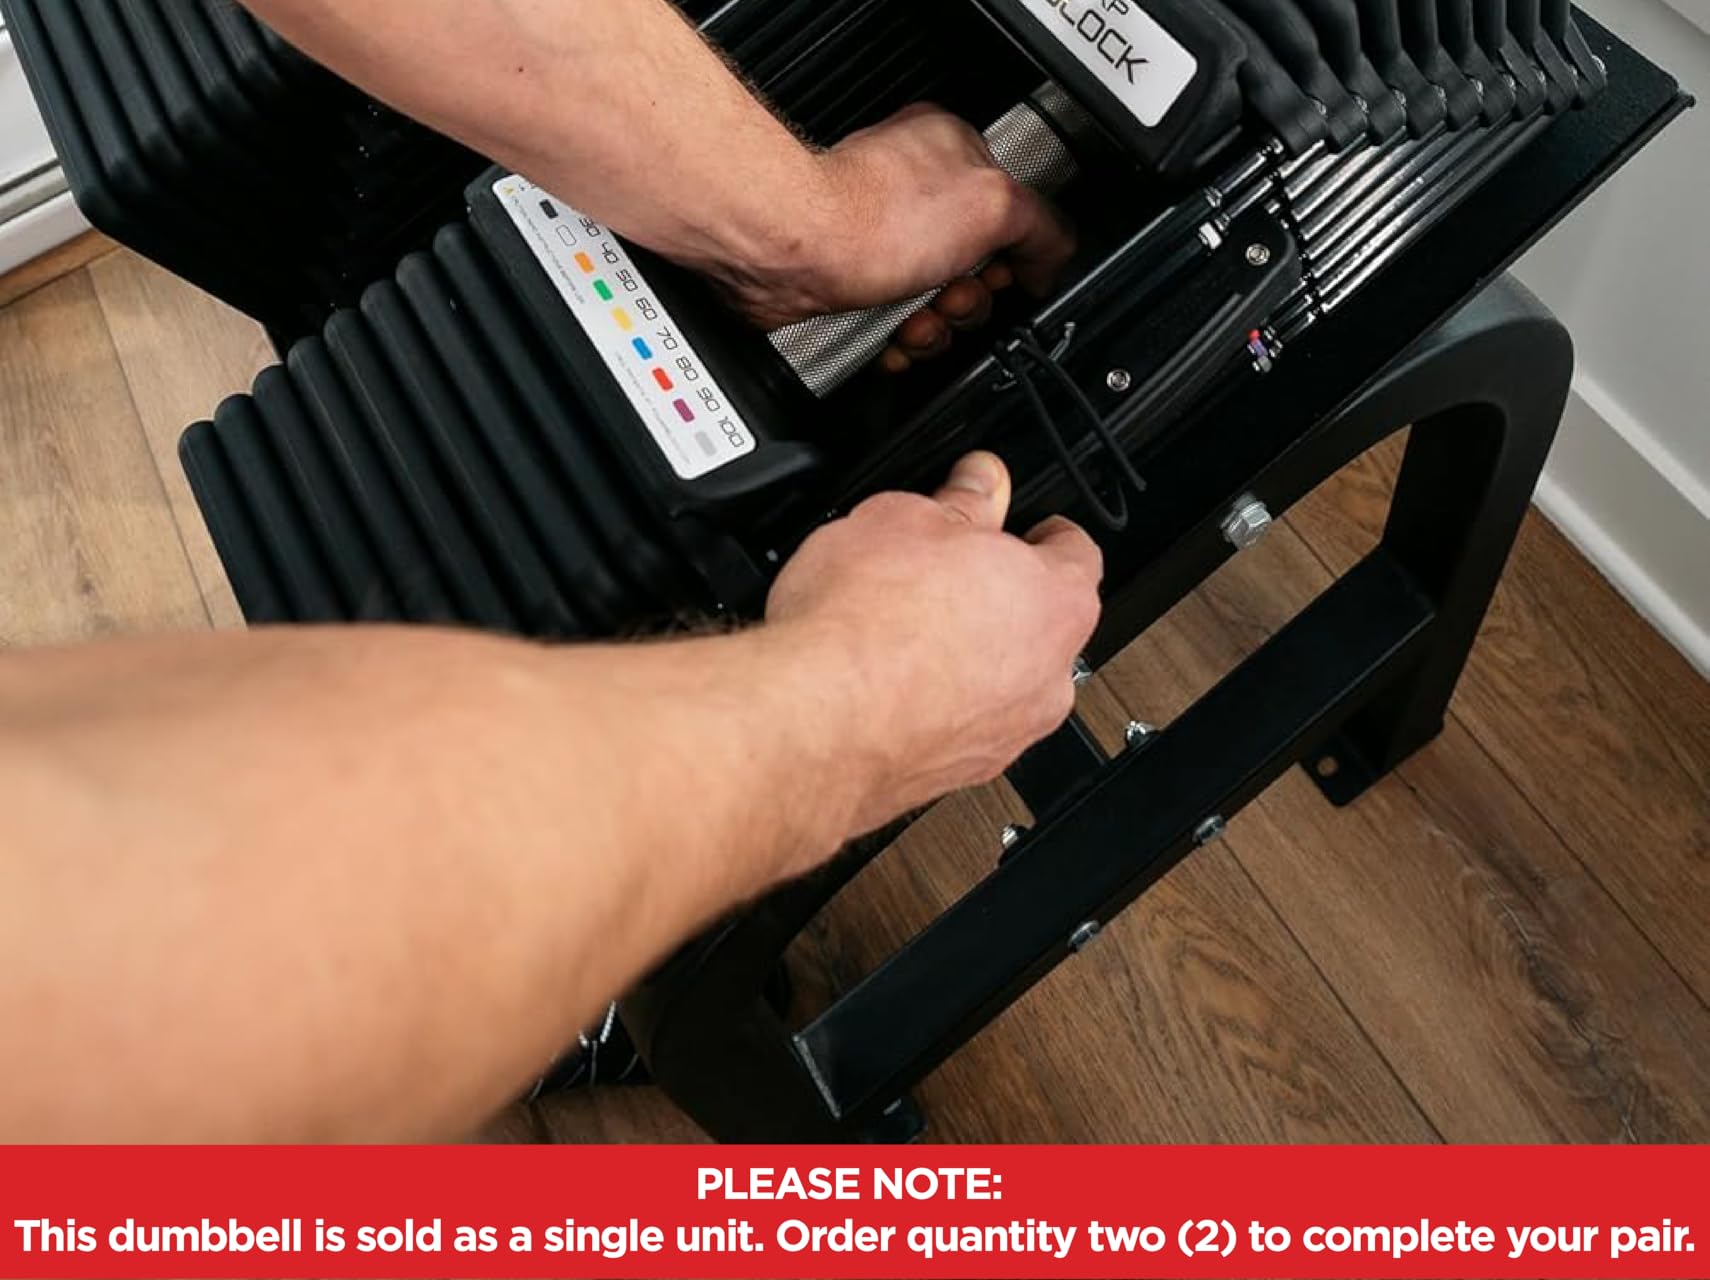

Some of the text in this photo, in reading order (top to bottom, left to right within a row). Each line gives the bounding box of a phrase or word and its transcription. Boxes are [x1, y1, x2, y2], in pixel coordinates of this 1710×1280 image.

[601, 241, 619, 264] 40
[616, 269, 638, 292] 50
[635, 297, 658, 321] 60
[656, 326, 678, 350] 70
[675, 356, 699, 381] 80
[696, 387, 720, 412] 90
[718, 416, 744, 448] 100
